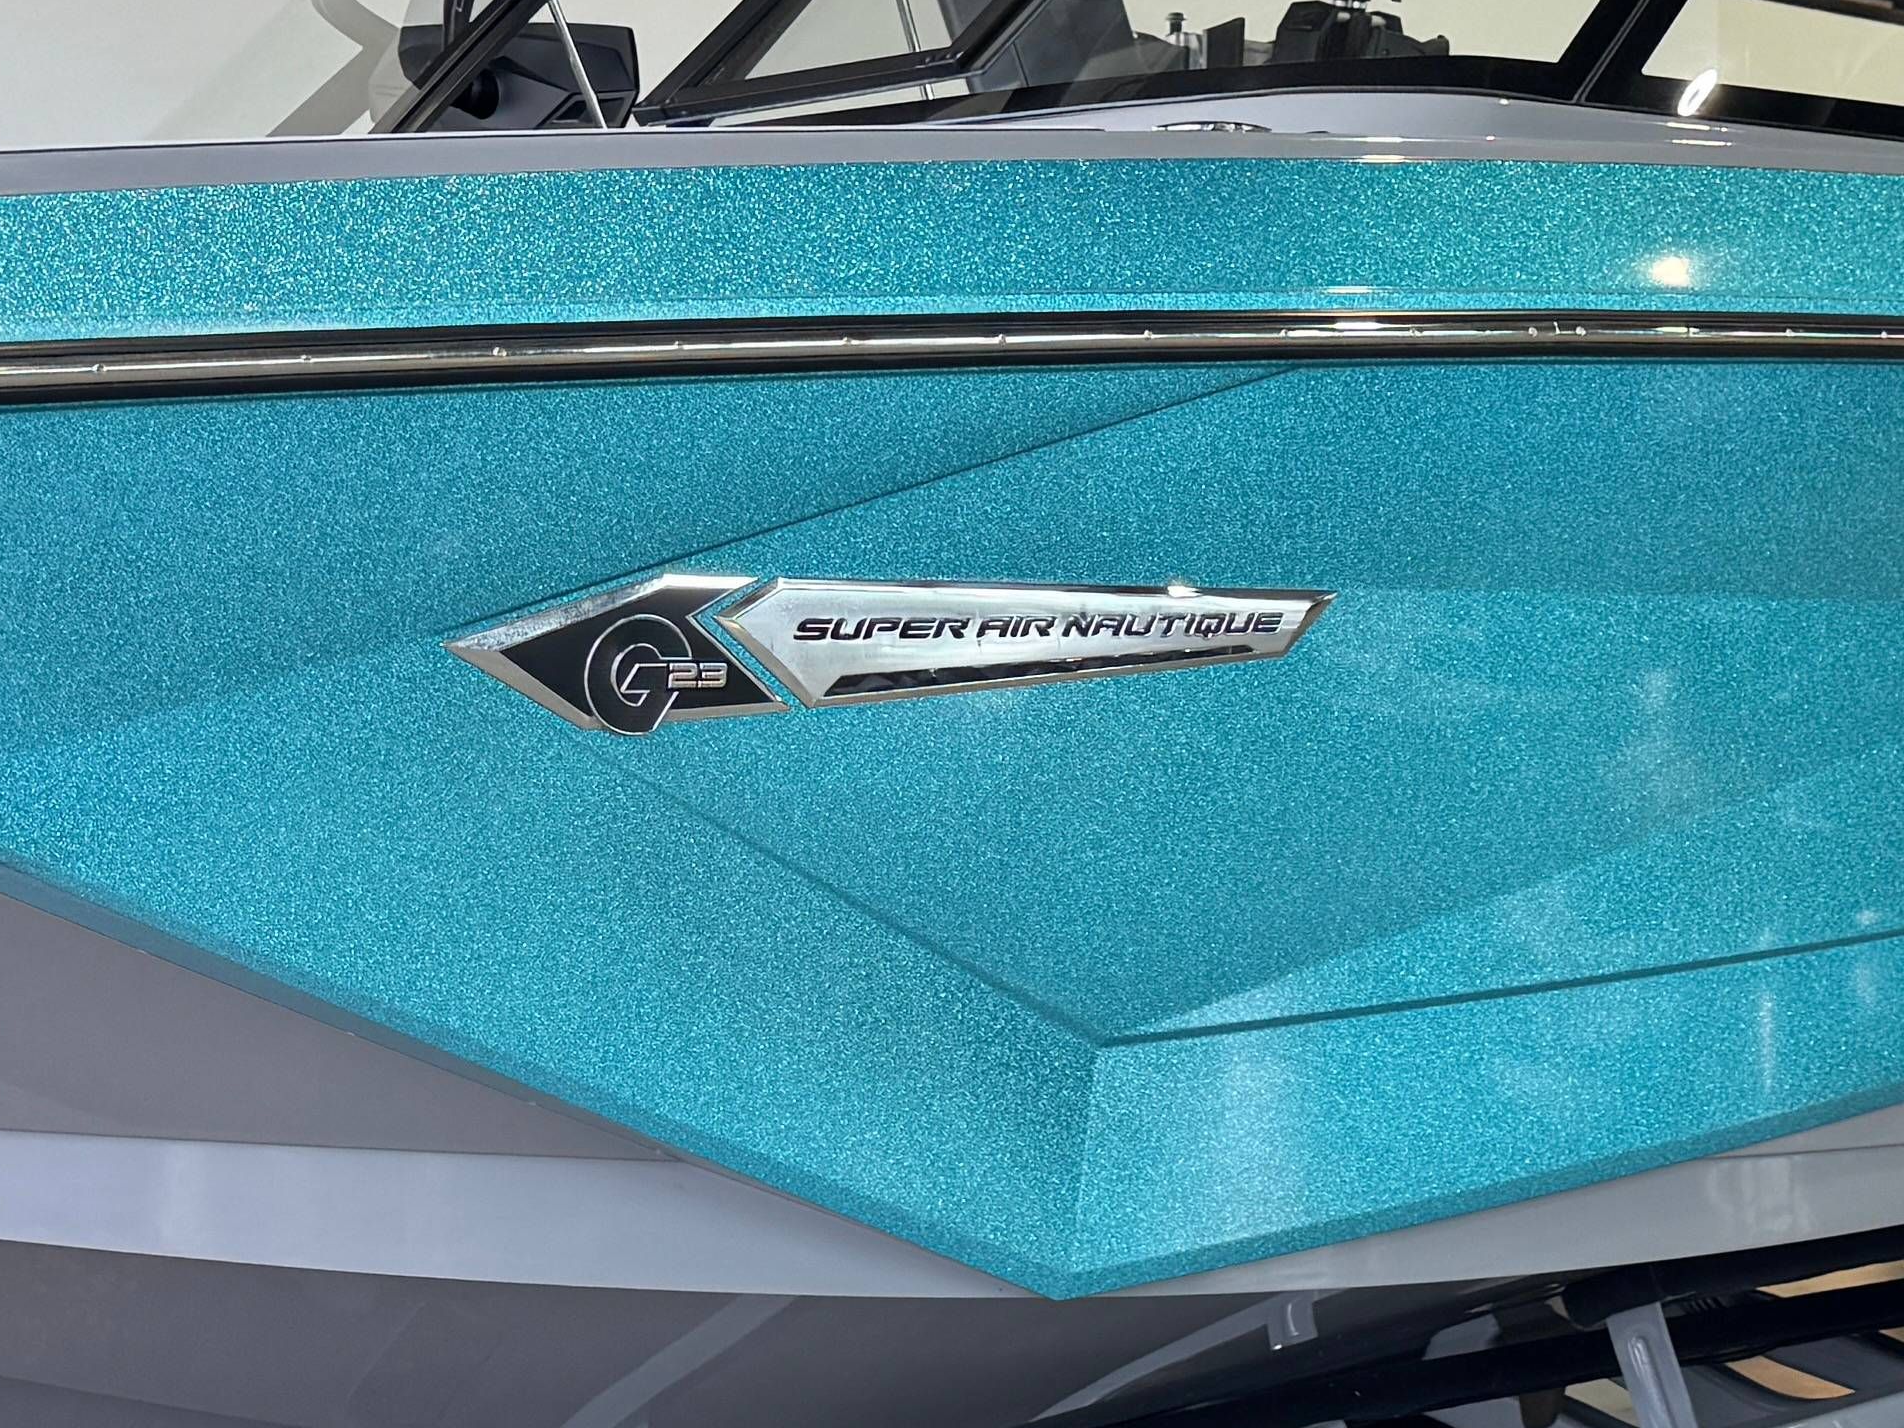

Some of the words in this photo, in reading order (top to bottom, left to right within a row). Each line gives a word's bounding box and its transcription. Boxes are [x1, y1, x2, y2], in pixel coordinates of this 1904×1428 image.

[793, 616, 969, 641] SUPER
[976, 616, 1056, 639] AIR
[1061, 612, 1285, 639] NAUTIQUE
